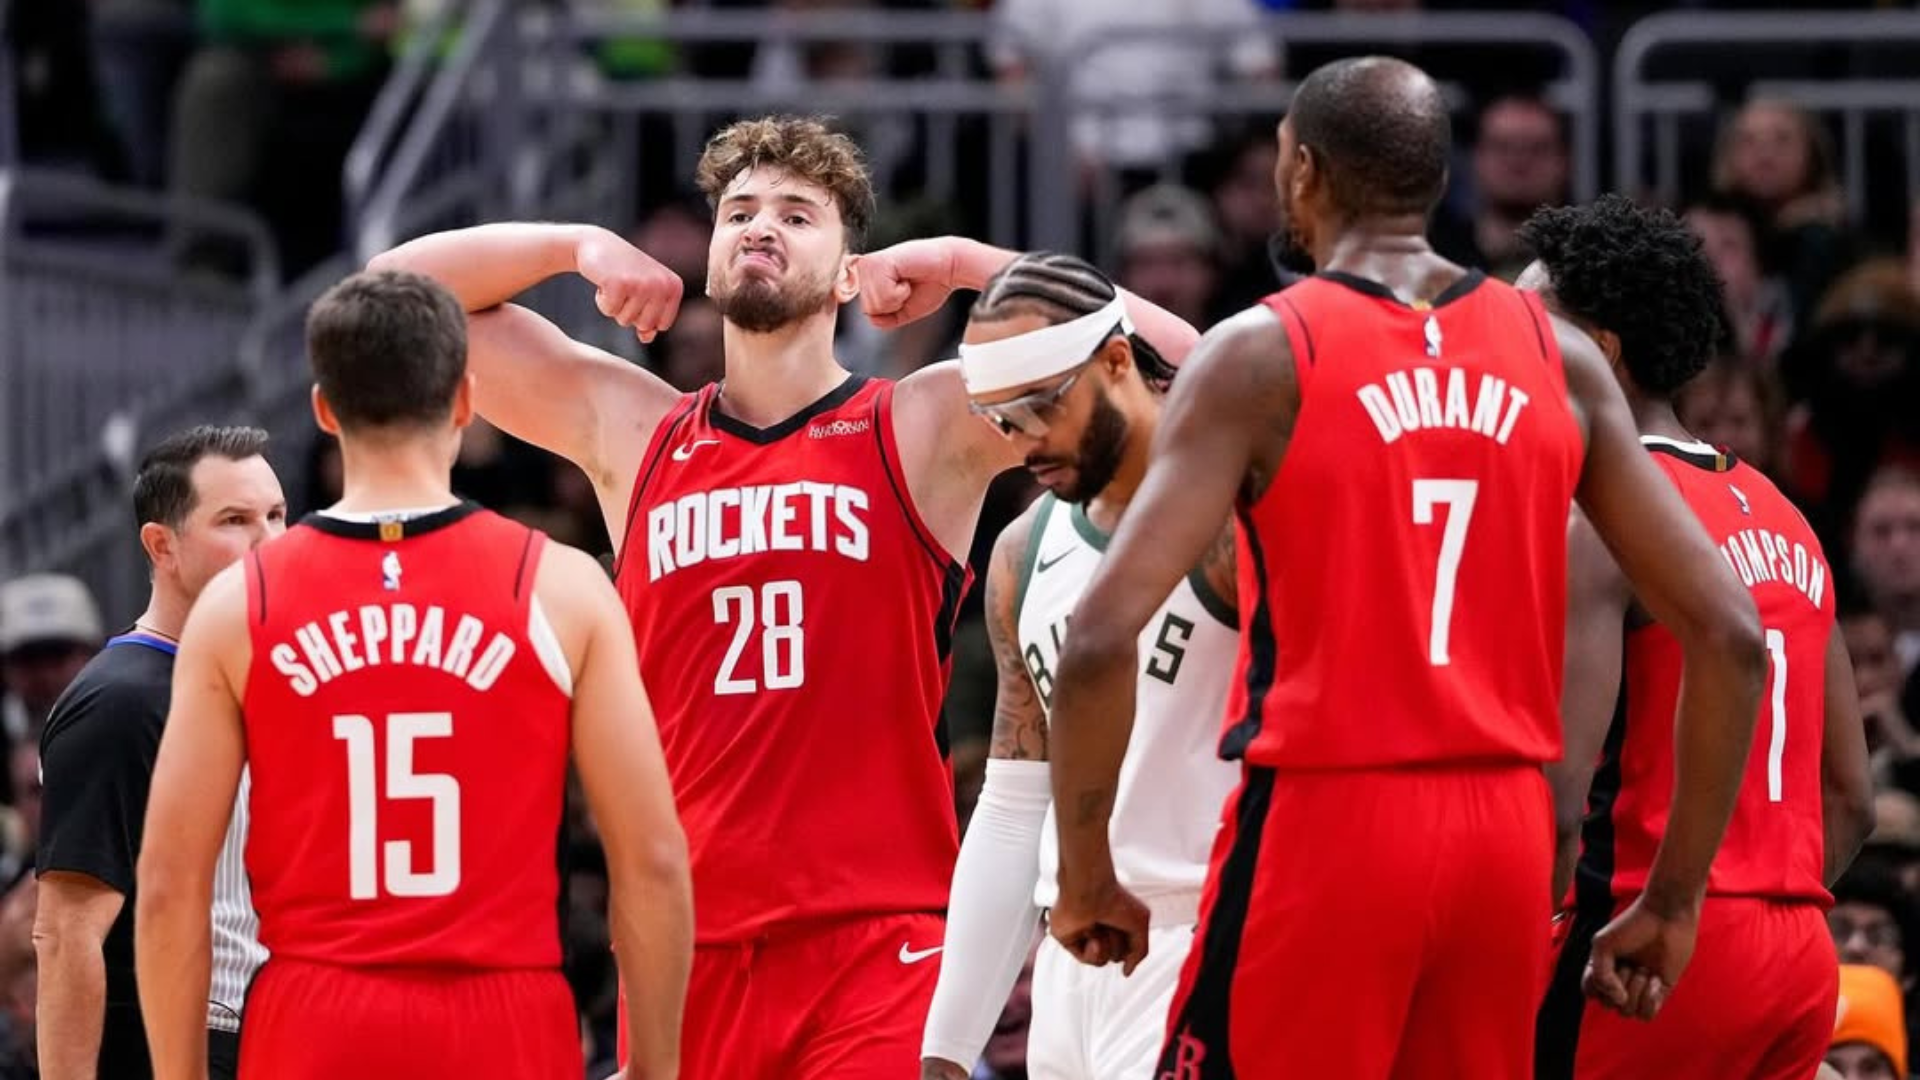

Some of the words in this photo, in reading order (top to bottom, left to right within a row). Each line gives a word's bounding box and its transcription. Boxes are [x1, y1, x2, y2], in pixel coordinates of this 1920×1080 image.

[1356, 367, 1529, 445] DURANT
[648, 480, 869, 583] ROCKETS
[1412, 478, 1479, 666] 7
[1720, 529, 1824, 610] OMPSON
[270, 603, 516, 696] SHEPPARD
[712, 580, 804, 695] 28
[1765, 629, 1787, 802] 1
[332, 711, 461, 900] 15
